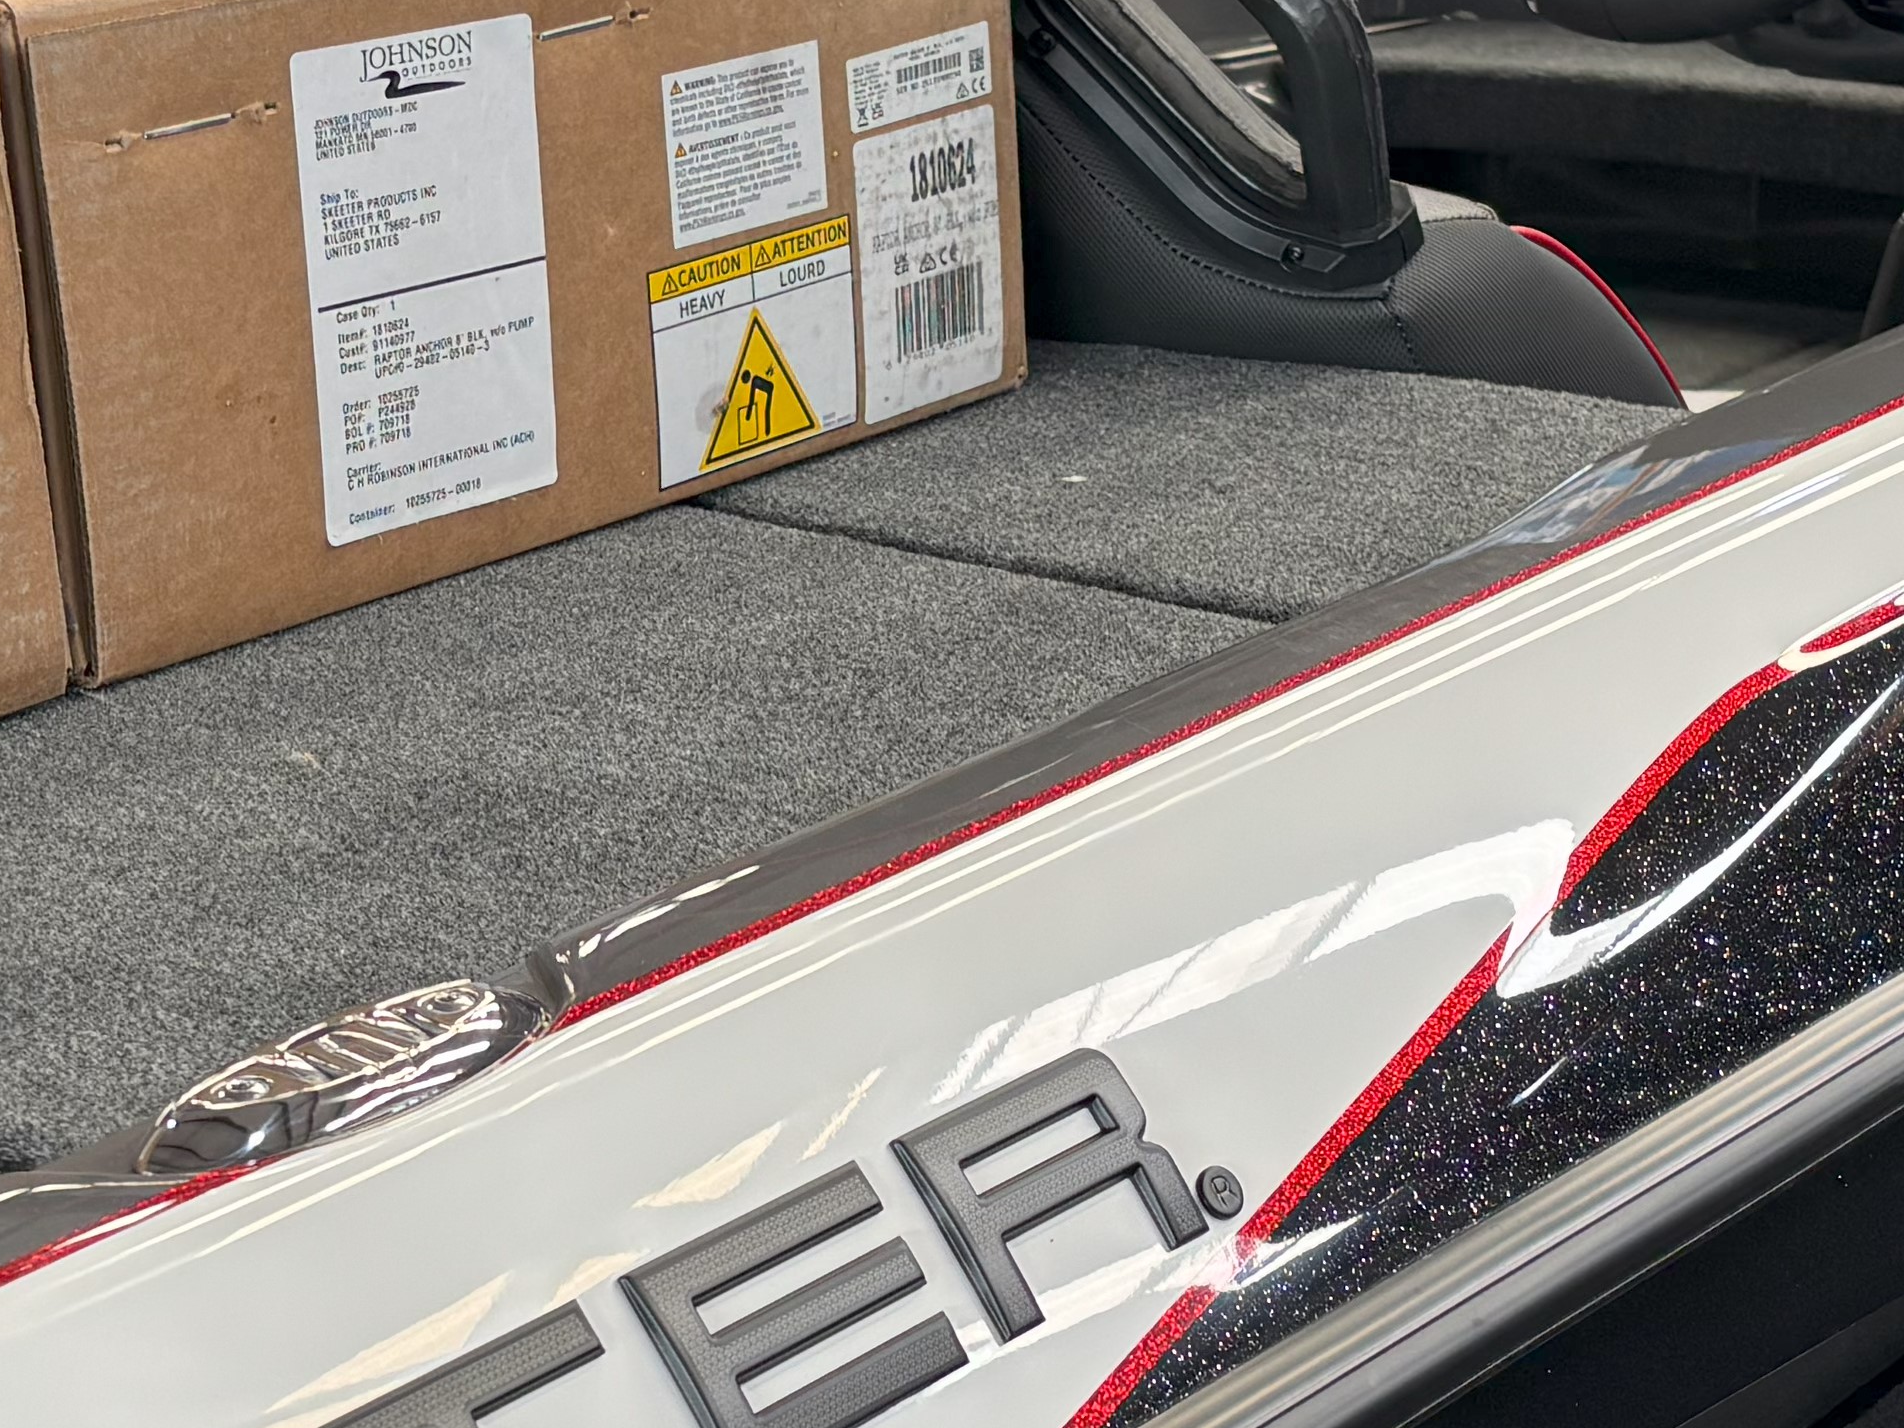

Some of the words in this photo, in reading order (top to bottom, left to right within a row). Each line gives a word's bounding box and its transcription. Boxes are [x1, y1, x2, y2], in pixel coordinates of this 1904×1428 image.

[359, 31, 473, 83] JOHNSON
[401, 56, 473, 78] OUTDOORS
[909, 137, 976, 203] 1810624
[319, 190, 341, 206] Ship
[344, 187, 358, 200] To:
[320, 200, 364, 220] SKEETER
[366, 189, 417, 210] PRODUCTS
[420, 184, 437, 199] INC
[322, 221, 328, 232] 1
[330, 211, 374, 231] SKEETER
[376, 208, 391, 221] RD
[323, 227, 365, 245] KILGORE
[368, 223, 380, 236] TX
[324, 241, 361, 260] UNITED
[363, 233, 399, 251] STATES
[772, 221, 847, 260] ATTENTION
[678, 252, 741, 288] CAUTION
[779, 258, 826, 288] LOURD
[336, 308, 358, 324] Case
[390, 299, 395, 310] 1
[679, 288, 726, 319] HEAVY
[372, 317, 409, 336] 1810624
[372, 330, 415, 351] 91140977
[374, 347, 412, 366] RAPTOR
[414, 336, 452, 355] ANCHOR
[507, 315, 534, 332] PUMP
[342, 397, 371, 415] Order:
[377, 384, 419, 406] 10255725
[377, 398, 416, 418] P244928
[345, 439, 365, 455] PRO
[380, 426, 411, 445] 709718
[346, 459, 381, 479] Carrier:
[347, 480, 355, 492] C
[356, 476, 365, 489] H
[367, 462, 415, 486] ROBINSON
[417, 441, 489, 472] INTERNATIONAL
[492, 436, 508, 451] INC
